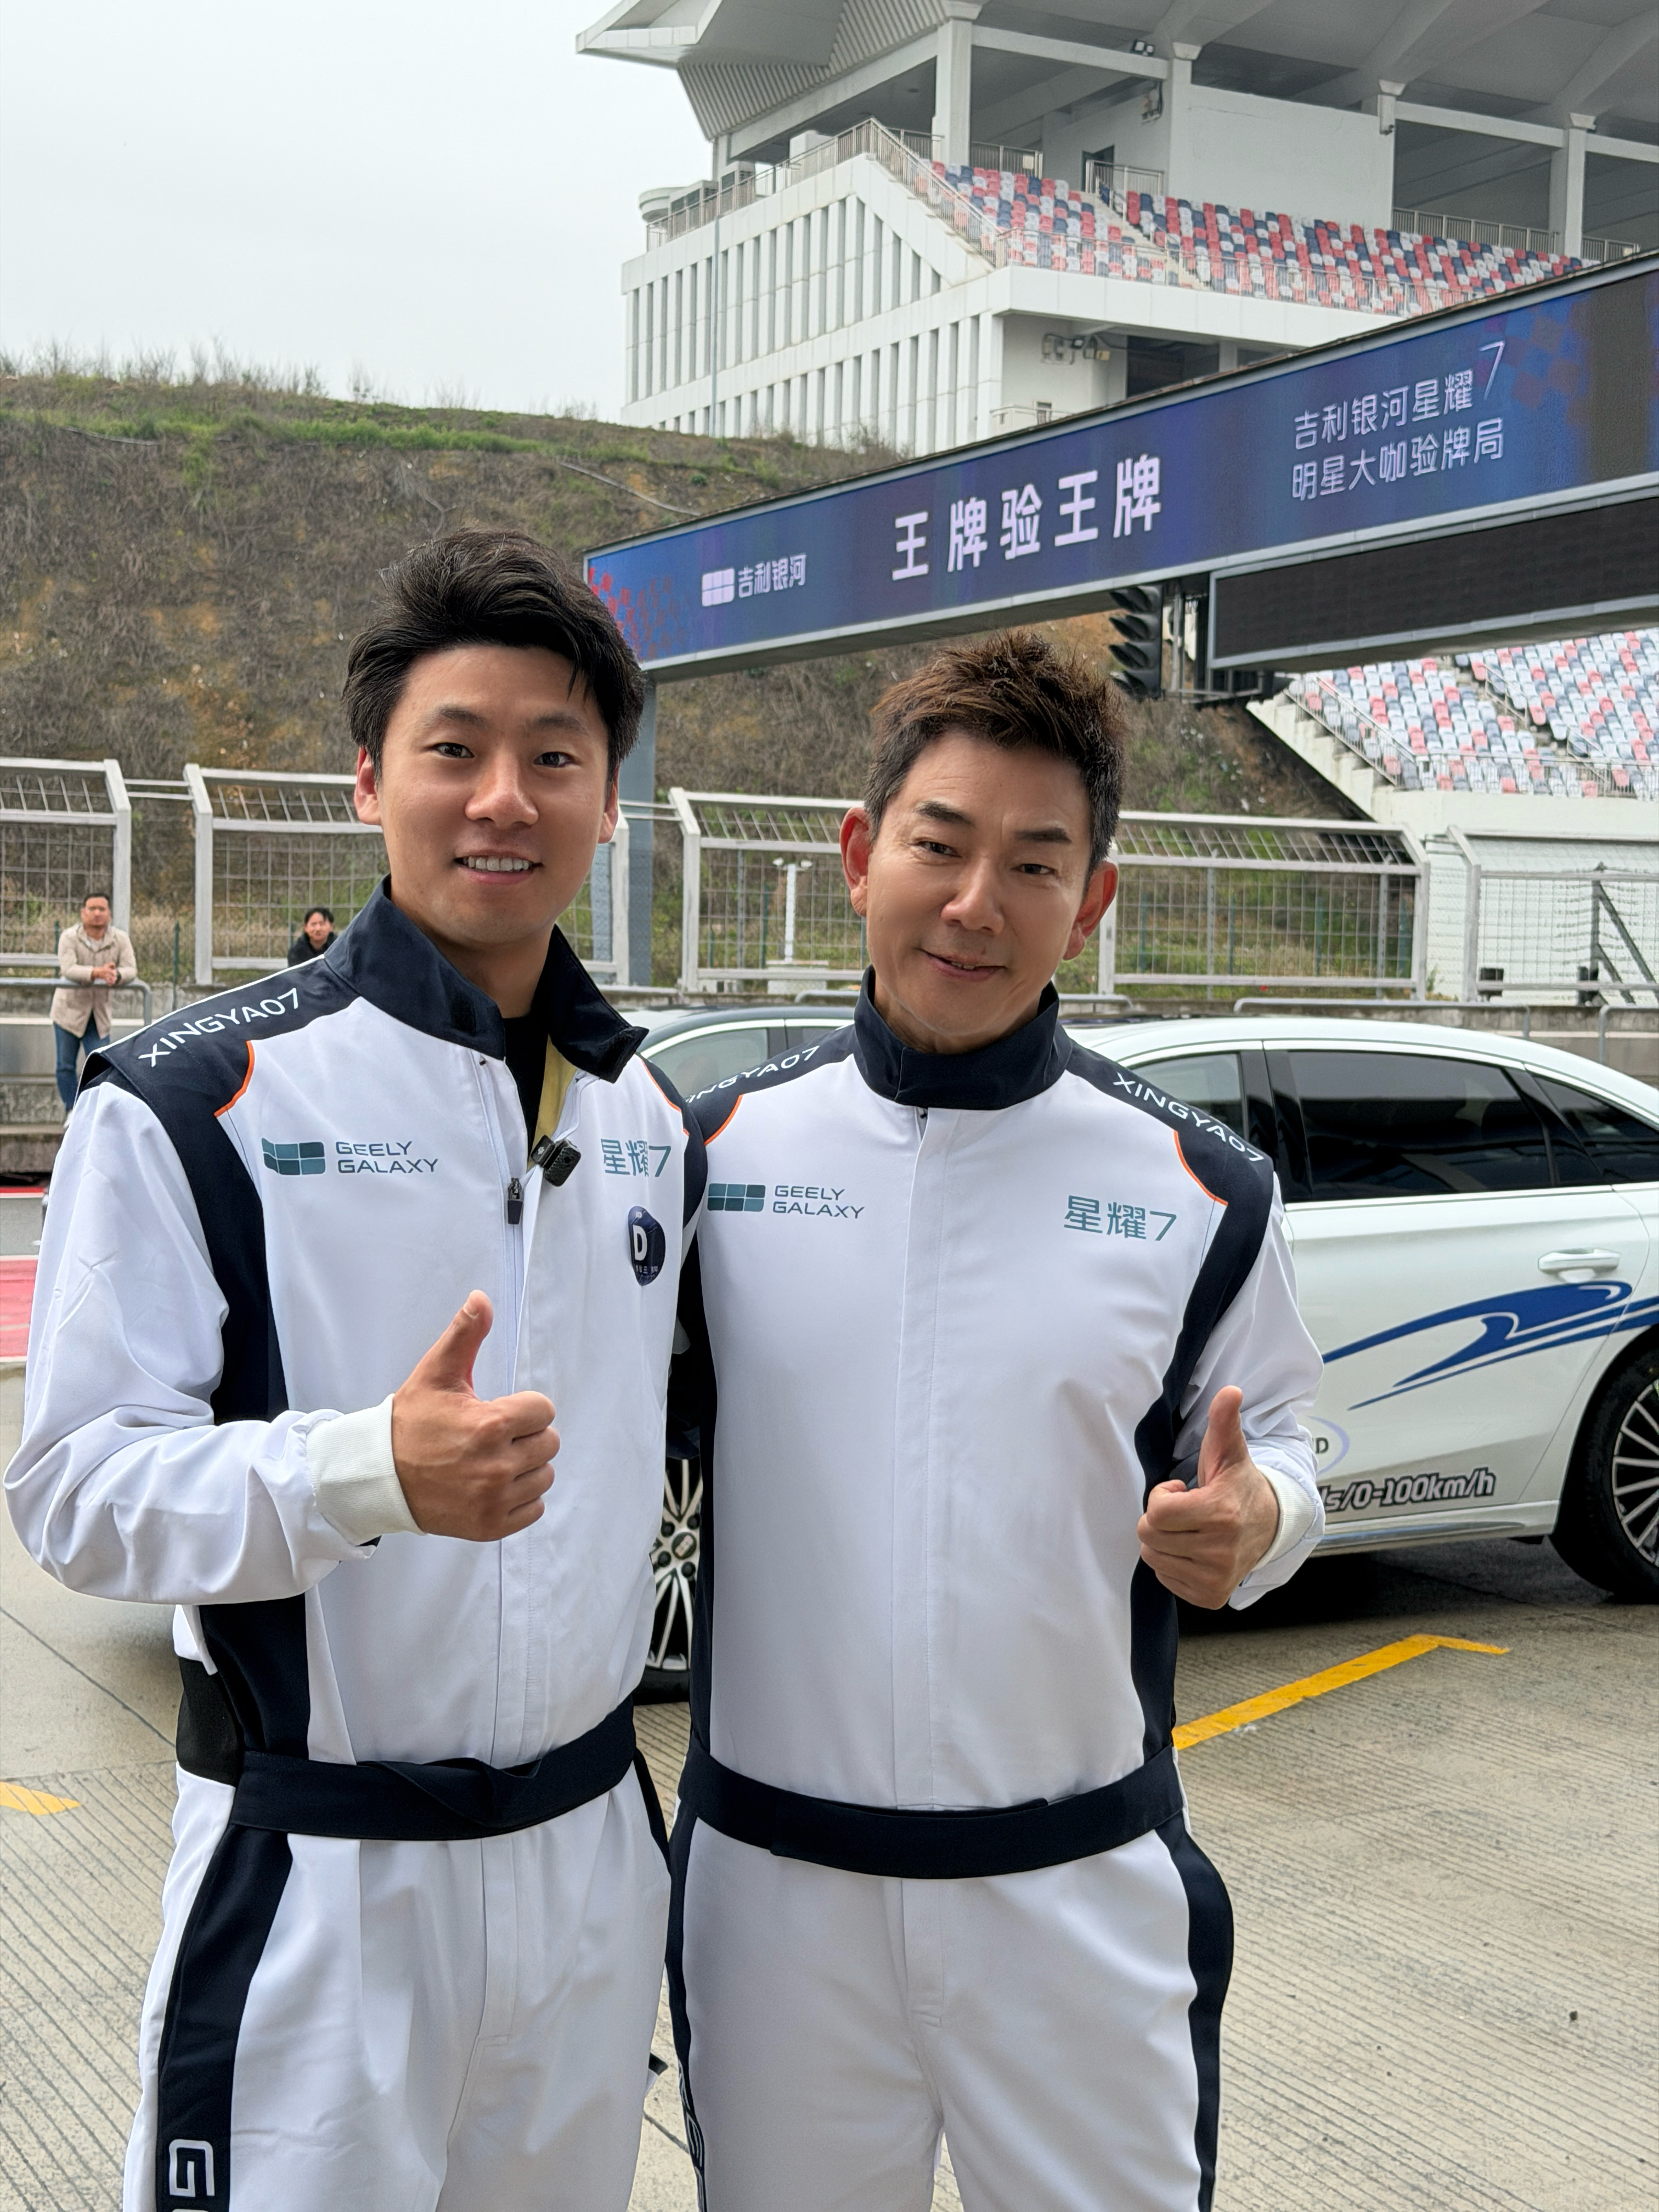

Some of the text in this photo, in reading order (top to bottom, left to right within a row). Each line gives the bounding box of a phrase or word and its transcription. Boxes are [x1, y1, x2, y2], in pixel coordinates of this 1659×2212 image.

[1294, 340, 1504, 450] 吉利银河星耀7
[1291, 417, 1504, 501] 明星大咖验牌局
[891, 453, 1161, 580] 王牌验王牌
[737, 552, 807, 599] 吉利银河
[335, 1141, 413, 1156] GEELY
[337, 1158, 438, 1173] GALAXY
[772, 1201, 865, 1219] GALAXY
[774, 1184, 845, 1201] GEELY
[1063, 1194, 1177, 1242] 星耀7
[633, 1224, 648, 1261] D
[1312, 1436, 1329, 1454] D
